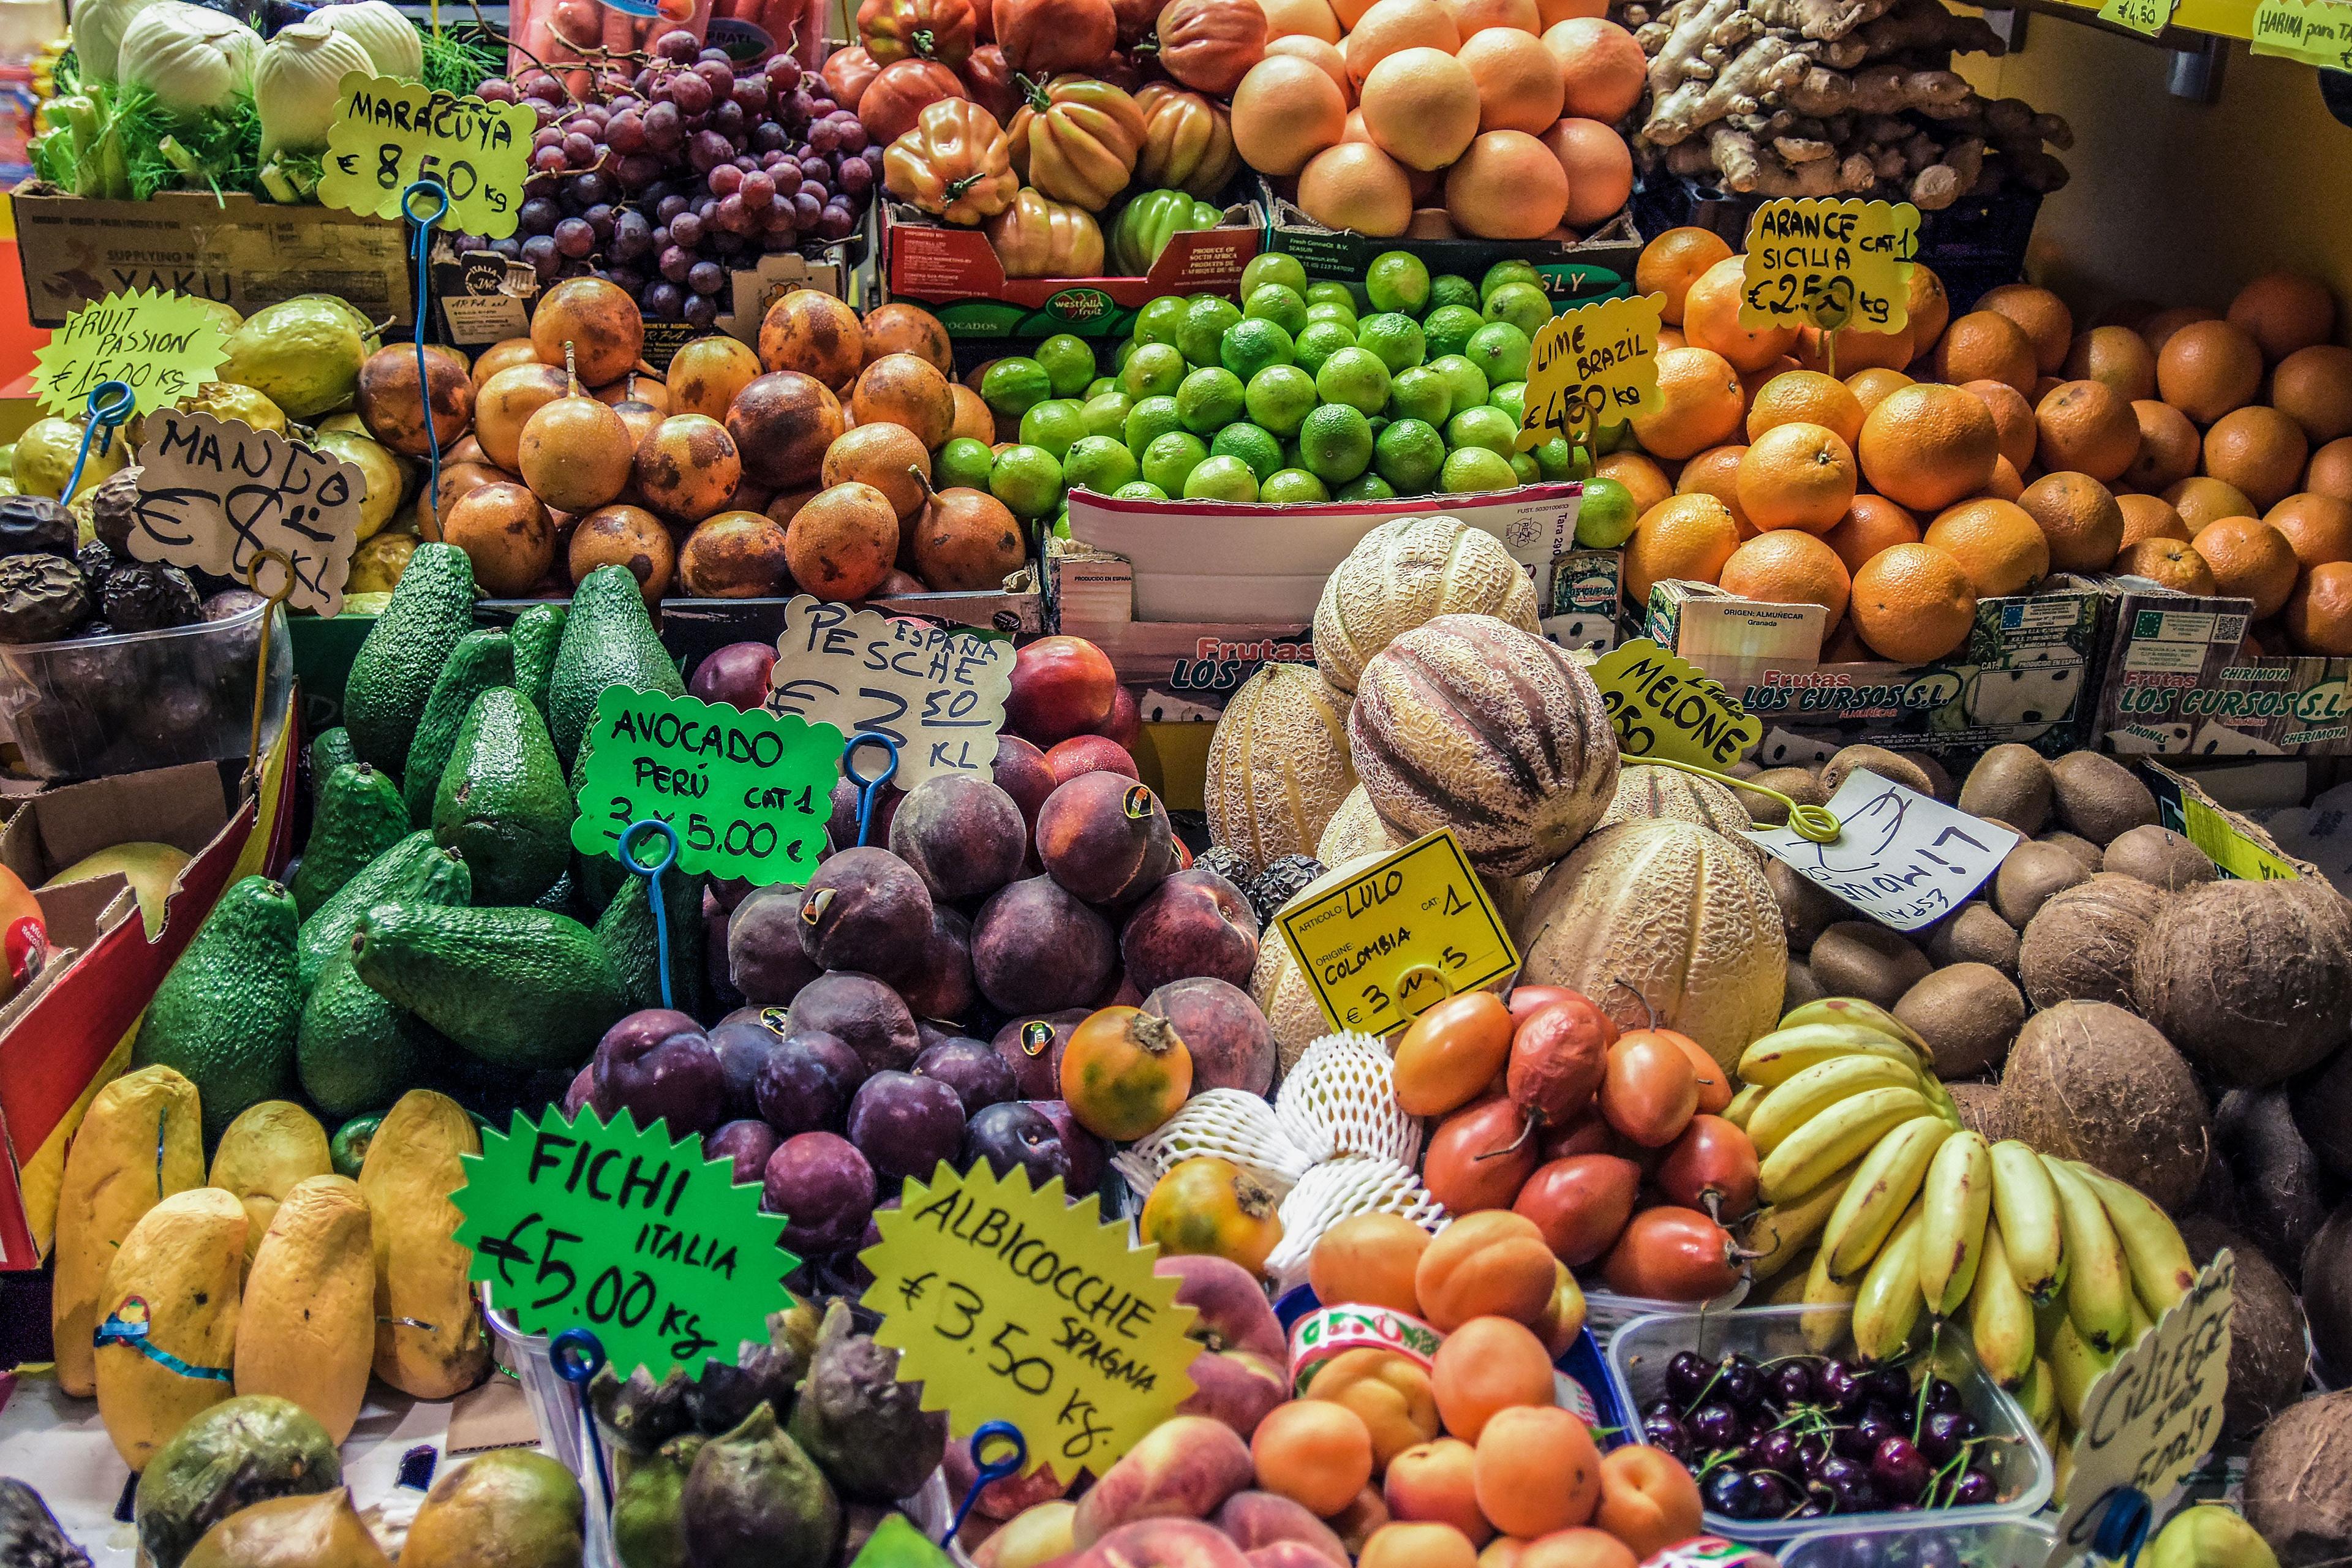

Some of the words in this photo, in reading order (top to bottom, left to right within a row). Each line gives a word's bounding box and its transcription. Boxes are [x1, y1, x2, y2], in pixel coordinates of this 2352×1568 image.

[349, 91, 511, 151] MARACUYA
[1761, 208, 1858, 243] ARANCE
[107, 249, 183, 263] SUPPLYING
[469, 265, 497, 277] ITALIA
[1763, 247, 1851, 270] SICILIA
[1542, 273, 1586, 292] SLY
[64, 307, 138, 344] FRUIT
[941, 321, 998, 331] VOCADOS
[1079, 307, 1102, 316] fruit
[96, 328, 200, 356] PASSION
[1538, 325, 1586, 372] LIME
[160, 420, 349, 507] MANGO
[1555, 513, 1568, 535] Tara
[803, 604, 987, 686] PESCHE
[1196, 637, 1315, 661] Frutas
[1169, 658, 1242, 689] LOS
[1763, 669, 1850, 688] Frutas
[2124, 671, 2197, 688] Frutas
[2220, 667, 2291, 681] CHIRIMOYA
[1618, 658, 1750, 764] MELONE
[1742, 685, 1793, 709] LOS
[1800, 684, 1905, 710] CURSOS
[1904, 683, 1950, 707] S.L.
[2119, 687, 2178, 714] LOS
[2181, 689, 2301, 718] CURSOS
[2297, 692, 2347, 718] S.L.
[611, 709, 784, 768] AVOCADO
[2125, 723, 2169, 744] ANONAS
[2281, 726, 2348, 745] CHERIMOYA
[929, 742, 979, 770] KL
[685, 812, 778, 858] 5.00
[1298, 905, 1345, 933] ARTICOLO:
[1346, 870, 1403, 919] LULO
[1421, 897, 1441, 911] CAT:
[1442, 884, 1472, 916] 1
[1316, 942, 1354, 967] ORIGINE:
[1325, 926, 1411, 985] COLOMBIA
[1362, 984, 1390, 1014] 3
[527, 1131, 691, 1216] FICHI
[634, 1223, 737, 1282] ITALIA
[914, 1189, 1156, 1340] ALBICOCCHE
[1052, 1316, 1158, 1395] SPAGNA
